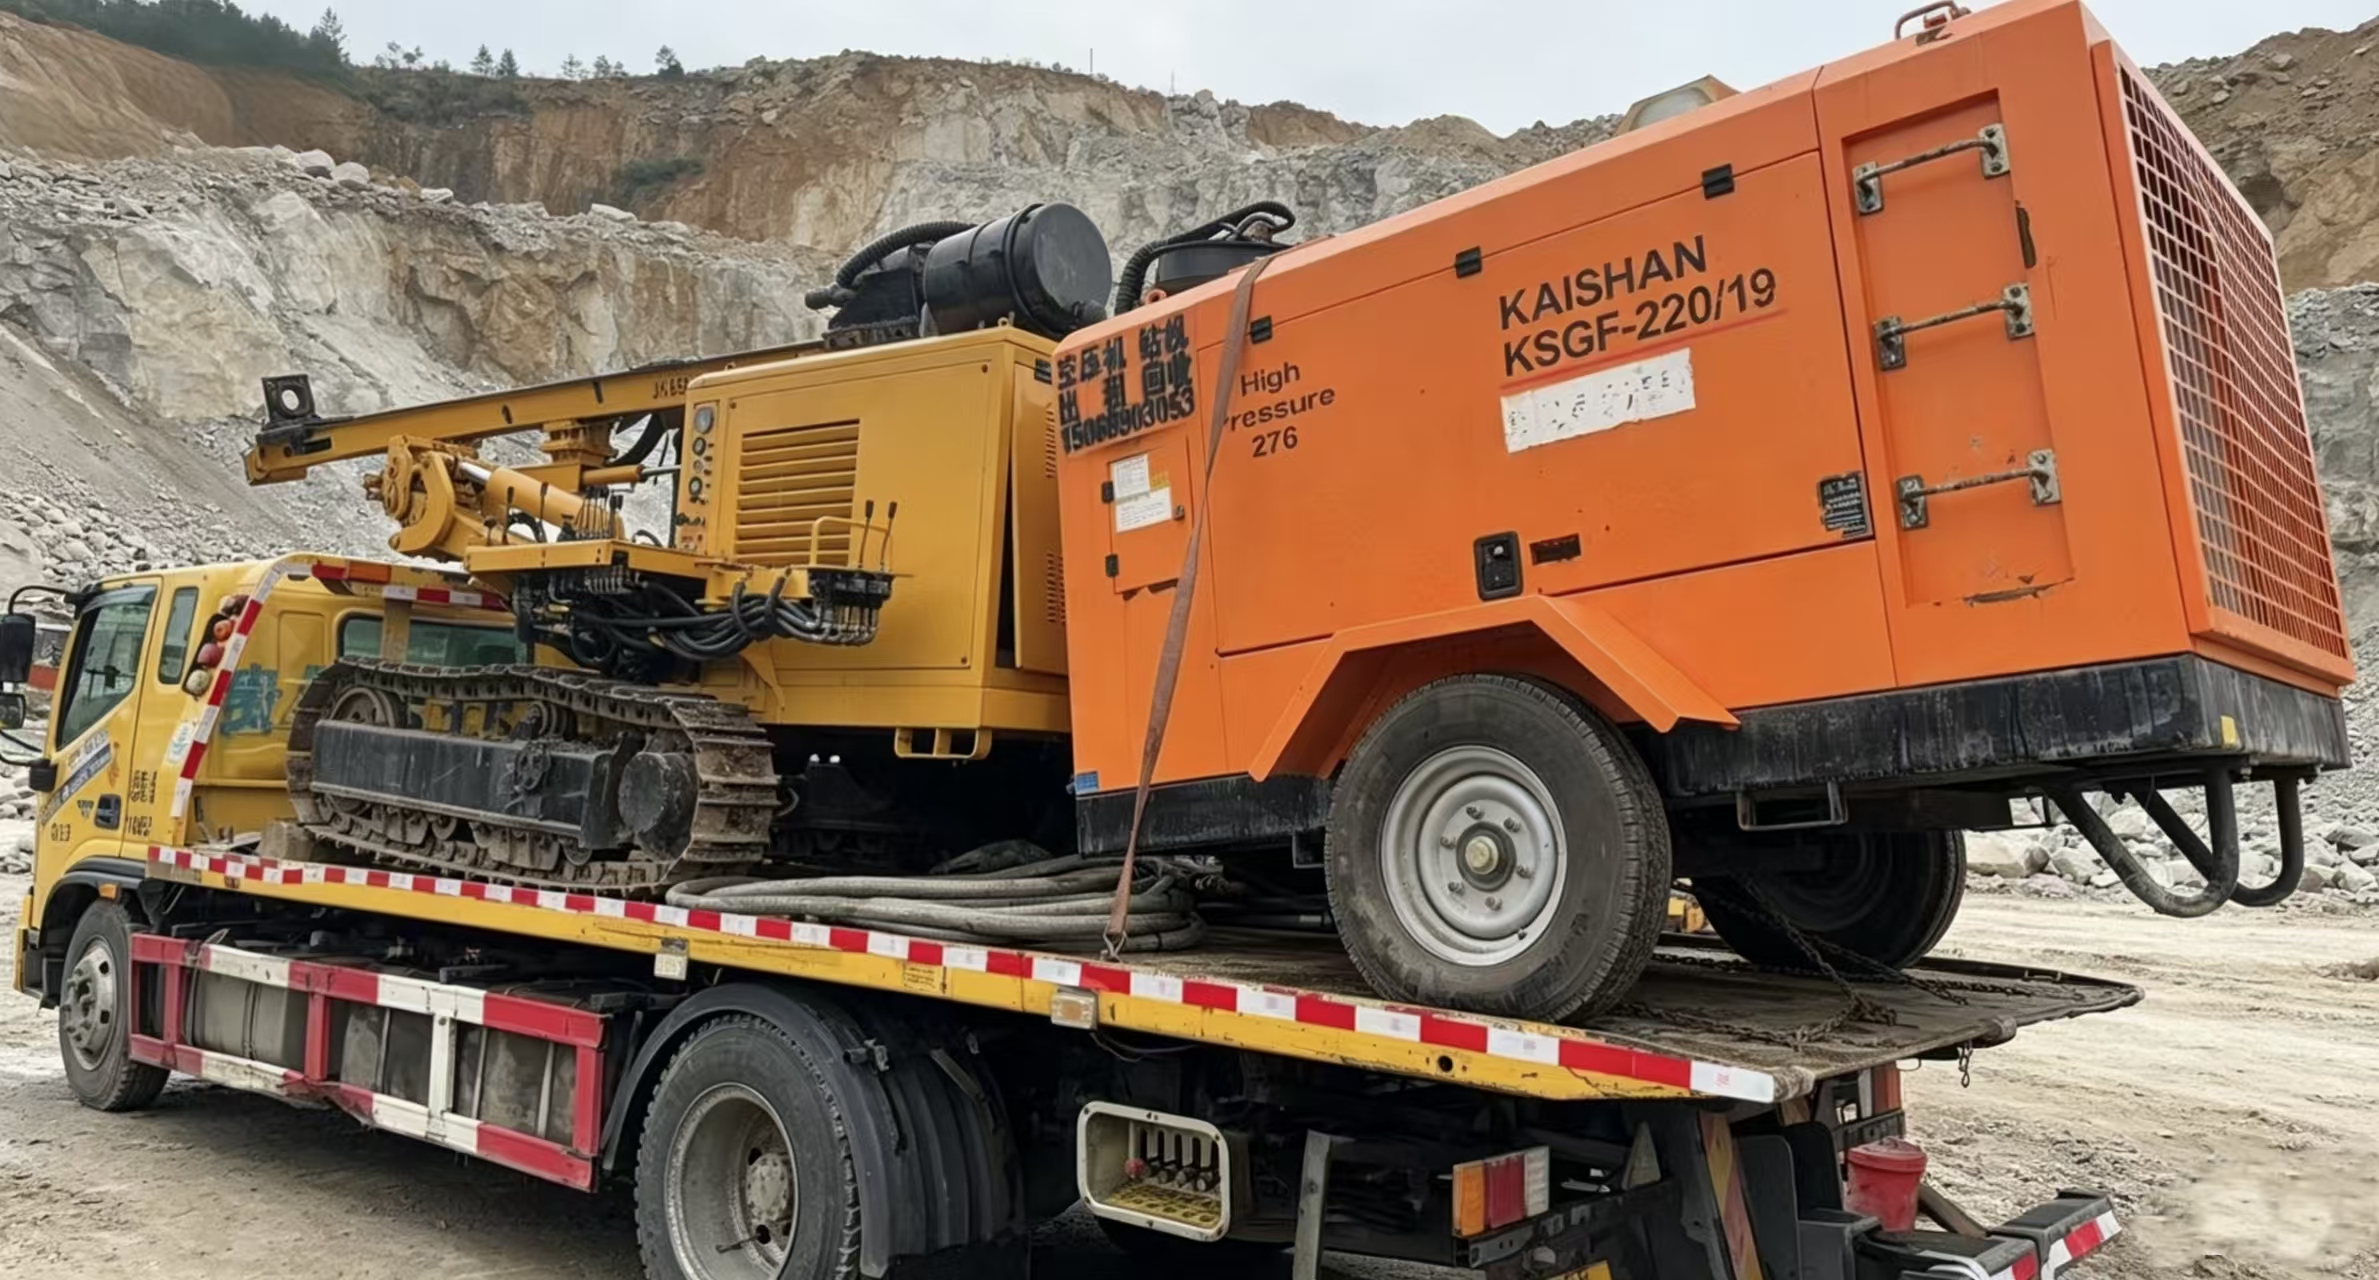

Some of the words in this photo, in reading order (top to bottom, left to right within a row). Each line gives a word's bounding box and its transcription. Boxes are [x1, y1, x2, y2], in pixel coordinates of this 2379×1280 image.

[1499, 234, 1708, 331] KAISHAN
[1504, 268, 1777, 377] KSGF-220/19
[1058, 336, 1126, 390] 空压机
[1240, 361, 1301, 397] High
[1223, 385, 1336, 432] ressure
[1252, 427, 1298, 458] 276
